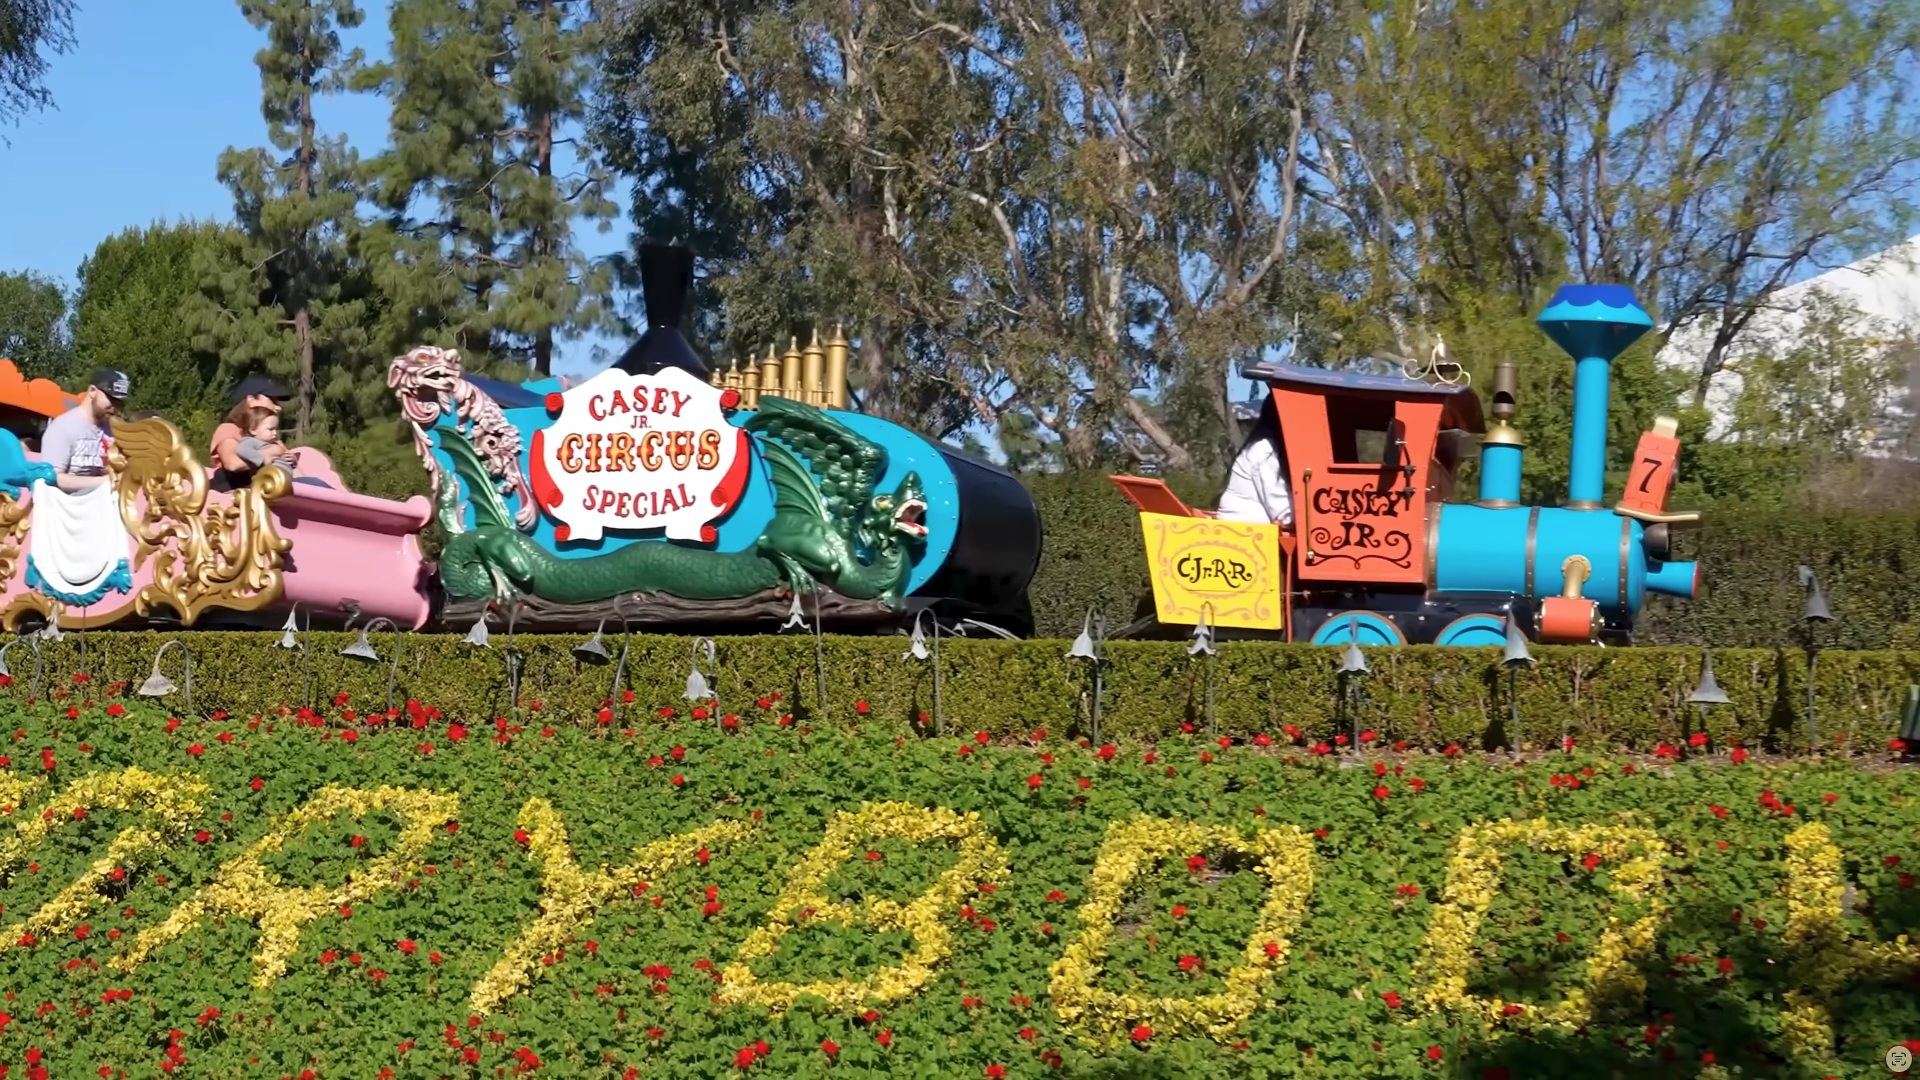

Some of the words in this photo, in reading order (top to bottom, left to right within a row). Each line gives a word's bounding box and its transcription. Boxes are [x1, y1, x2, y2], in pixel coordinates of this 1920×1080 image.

[589, 385, 692, 421] CASEY
[630, 415, 652, 429] JR.
[557, 429, 721, 474] CIRCUS
[1639, 457, 1663, 494] 7
[583, 483, 696, 518] SPECIAL
[1313, 483, 1411, 521] CASEY
[1331, 521, 1381, 551] JR
